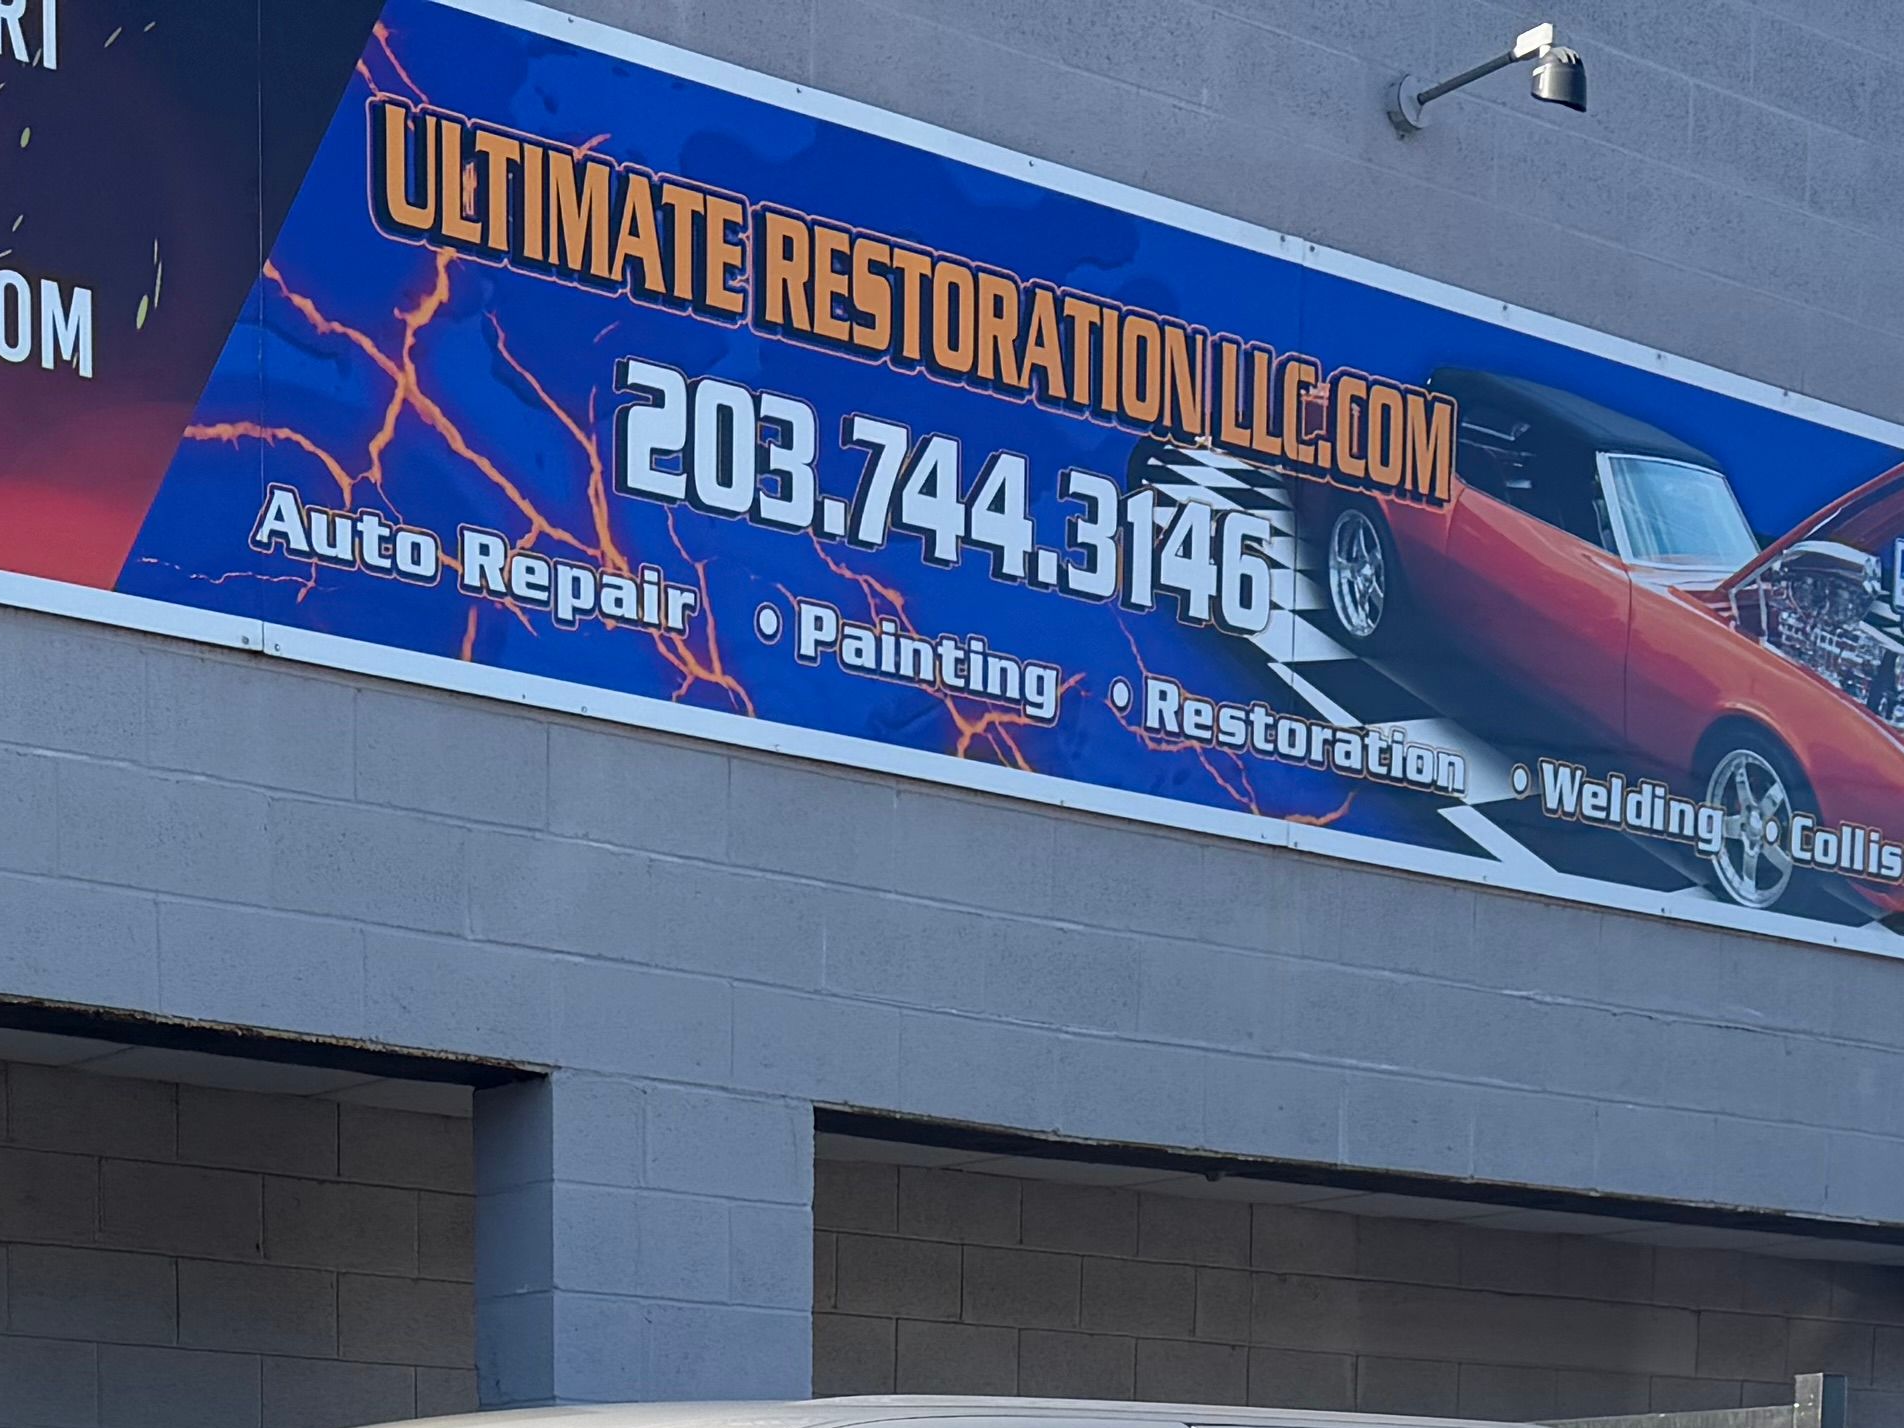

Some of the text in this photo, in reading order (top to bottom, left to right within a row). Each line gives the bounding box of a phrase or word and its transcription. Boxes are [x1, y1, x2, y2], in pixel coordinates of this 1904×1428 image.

[382, 102, 1455, 500] ULTIMATE RESTORATION LLC.COM
[254, 488, 438, 580] Auto
[462, 529, 696, 630] Repair
[799, 604, 1059, 720] Painting
[1143, 677, 1467, 794] Restoration
[1540, 761, 1725, 853] Welding
[622, 357, 1273, 633] 203.744.3146
